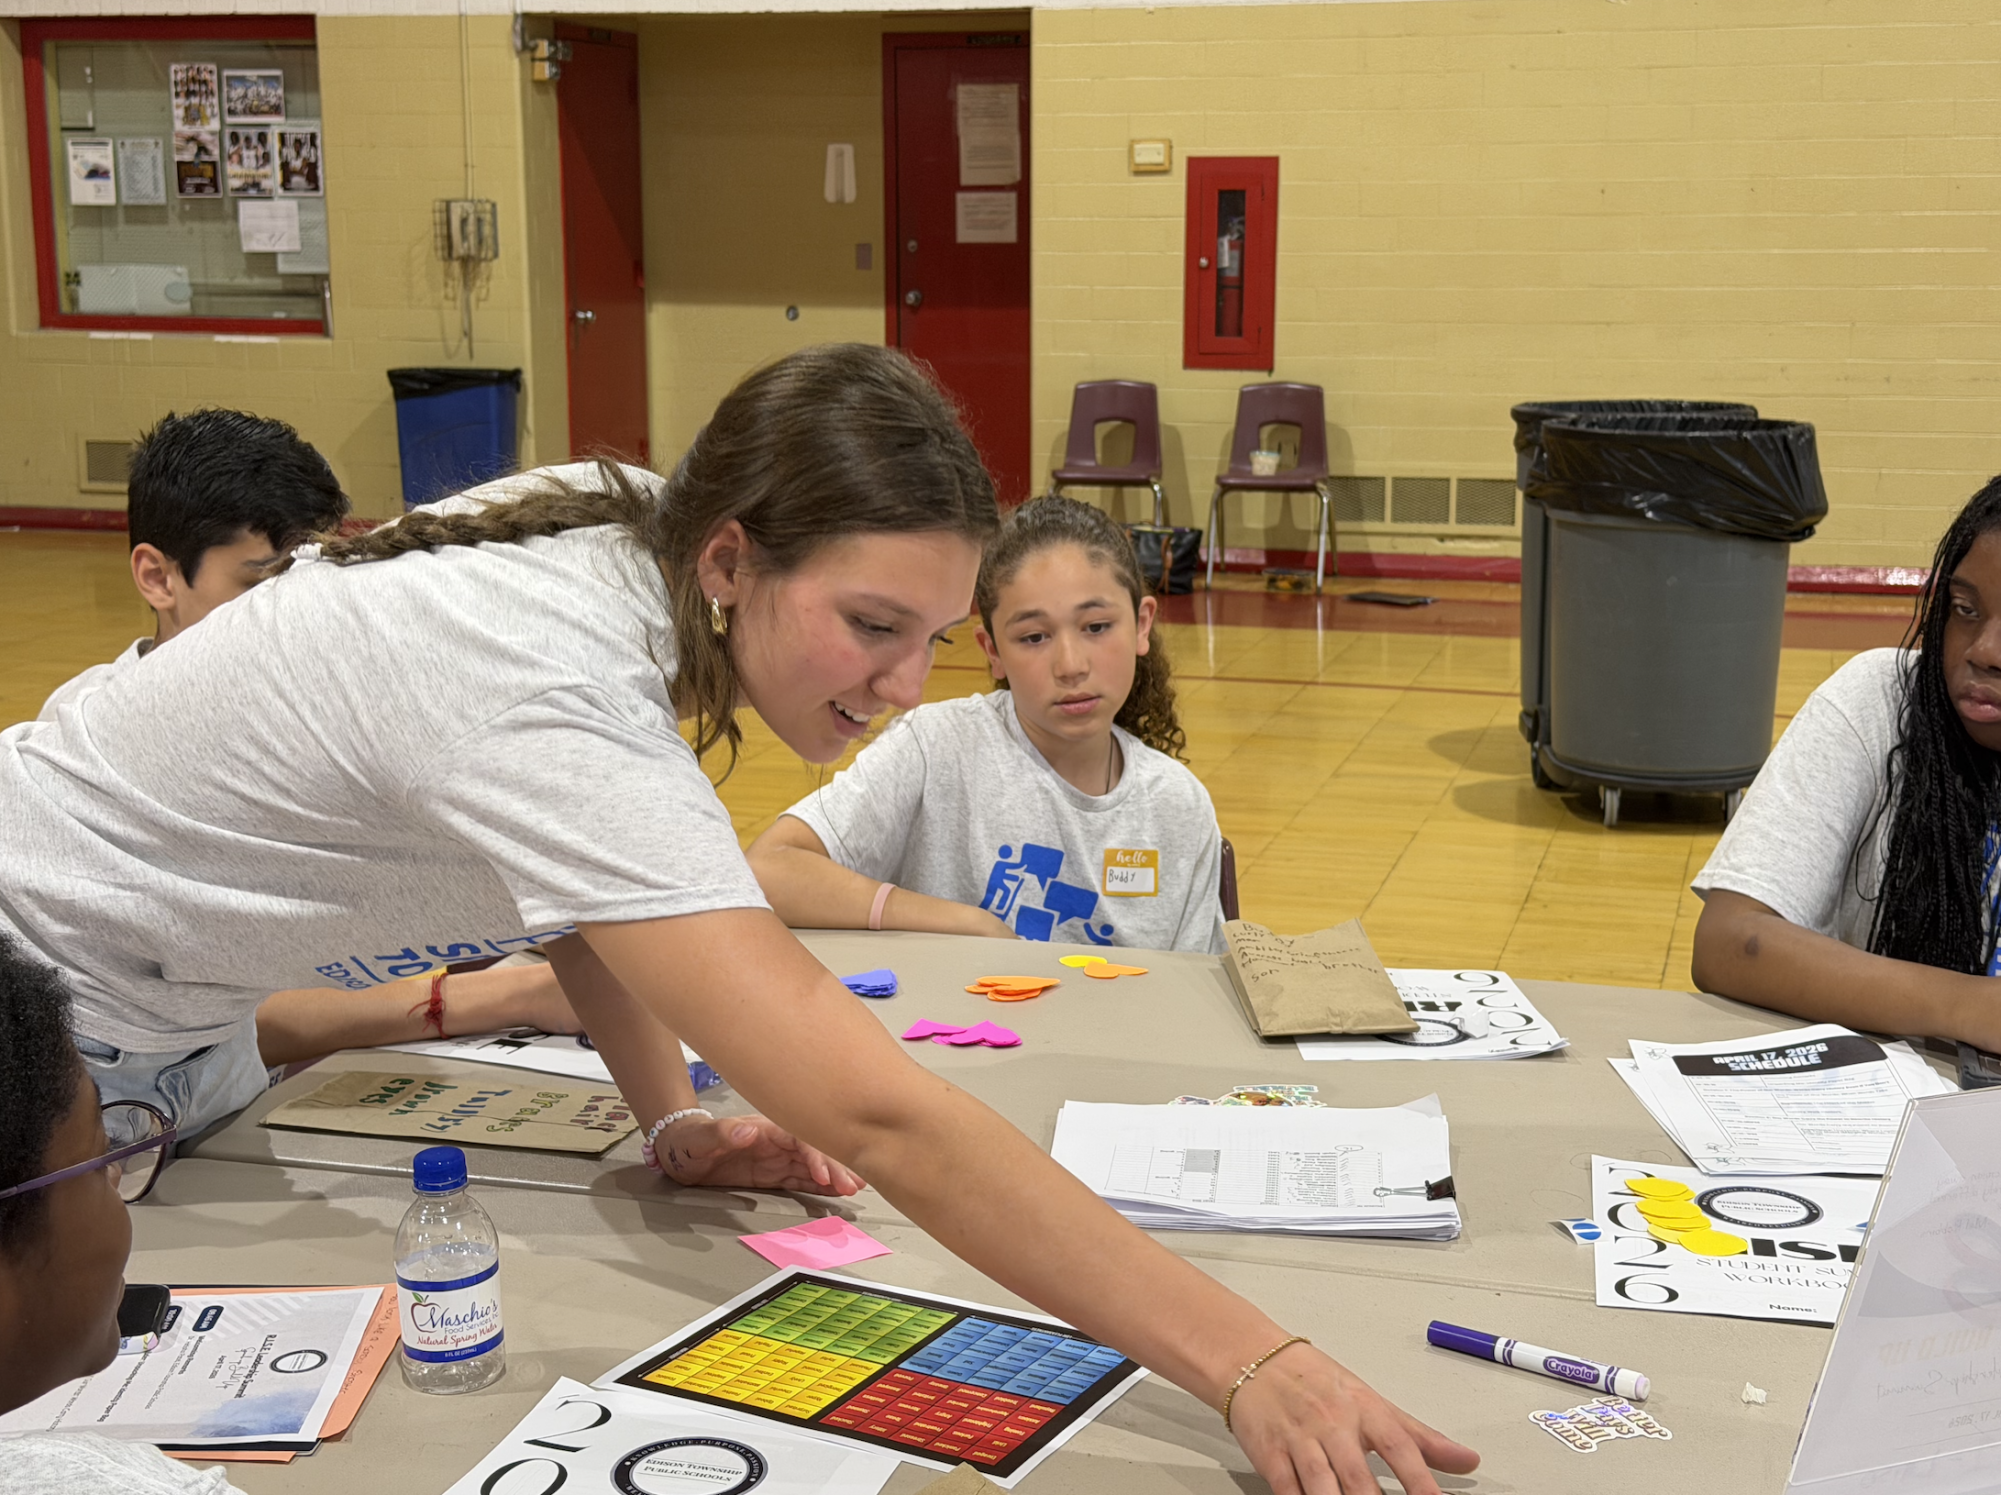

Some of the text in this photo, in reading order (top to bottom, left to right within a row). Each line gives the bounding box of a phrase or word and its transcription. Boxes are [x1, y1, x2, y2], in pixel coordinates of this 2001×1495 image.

[1115, 850, 1148, 865] hello
[1108, 868, 1137, 884] Buddy
[1712, 1042, 1829, 1065] APRIL 17, 2026
[1727, 1054, 1822, 1072] SCHEDULE
[1696, 1257, 1806, 1275] STUDENT
[418, 1298, 498, 1329] Maschio's
[1768, 1303, 1818, 1314] Name:
[444, 1318, 492, 1335] Food Services
[417, 1334, 449, 1346] Natural
[450, 1331, 478, 1348] Spring
[1547, 1358, 1594, 1381] Crayola
[1599, 1395, 1667, 1438] Better
[1532, 1409, 1594, 1451] Come
[643, 1466, 733, 1482] PUBLIC SCHOOLS
[645, 1458, 743, 1476] EDISON TOWNSHIP
